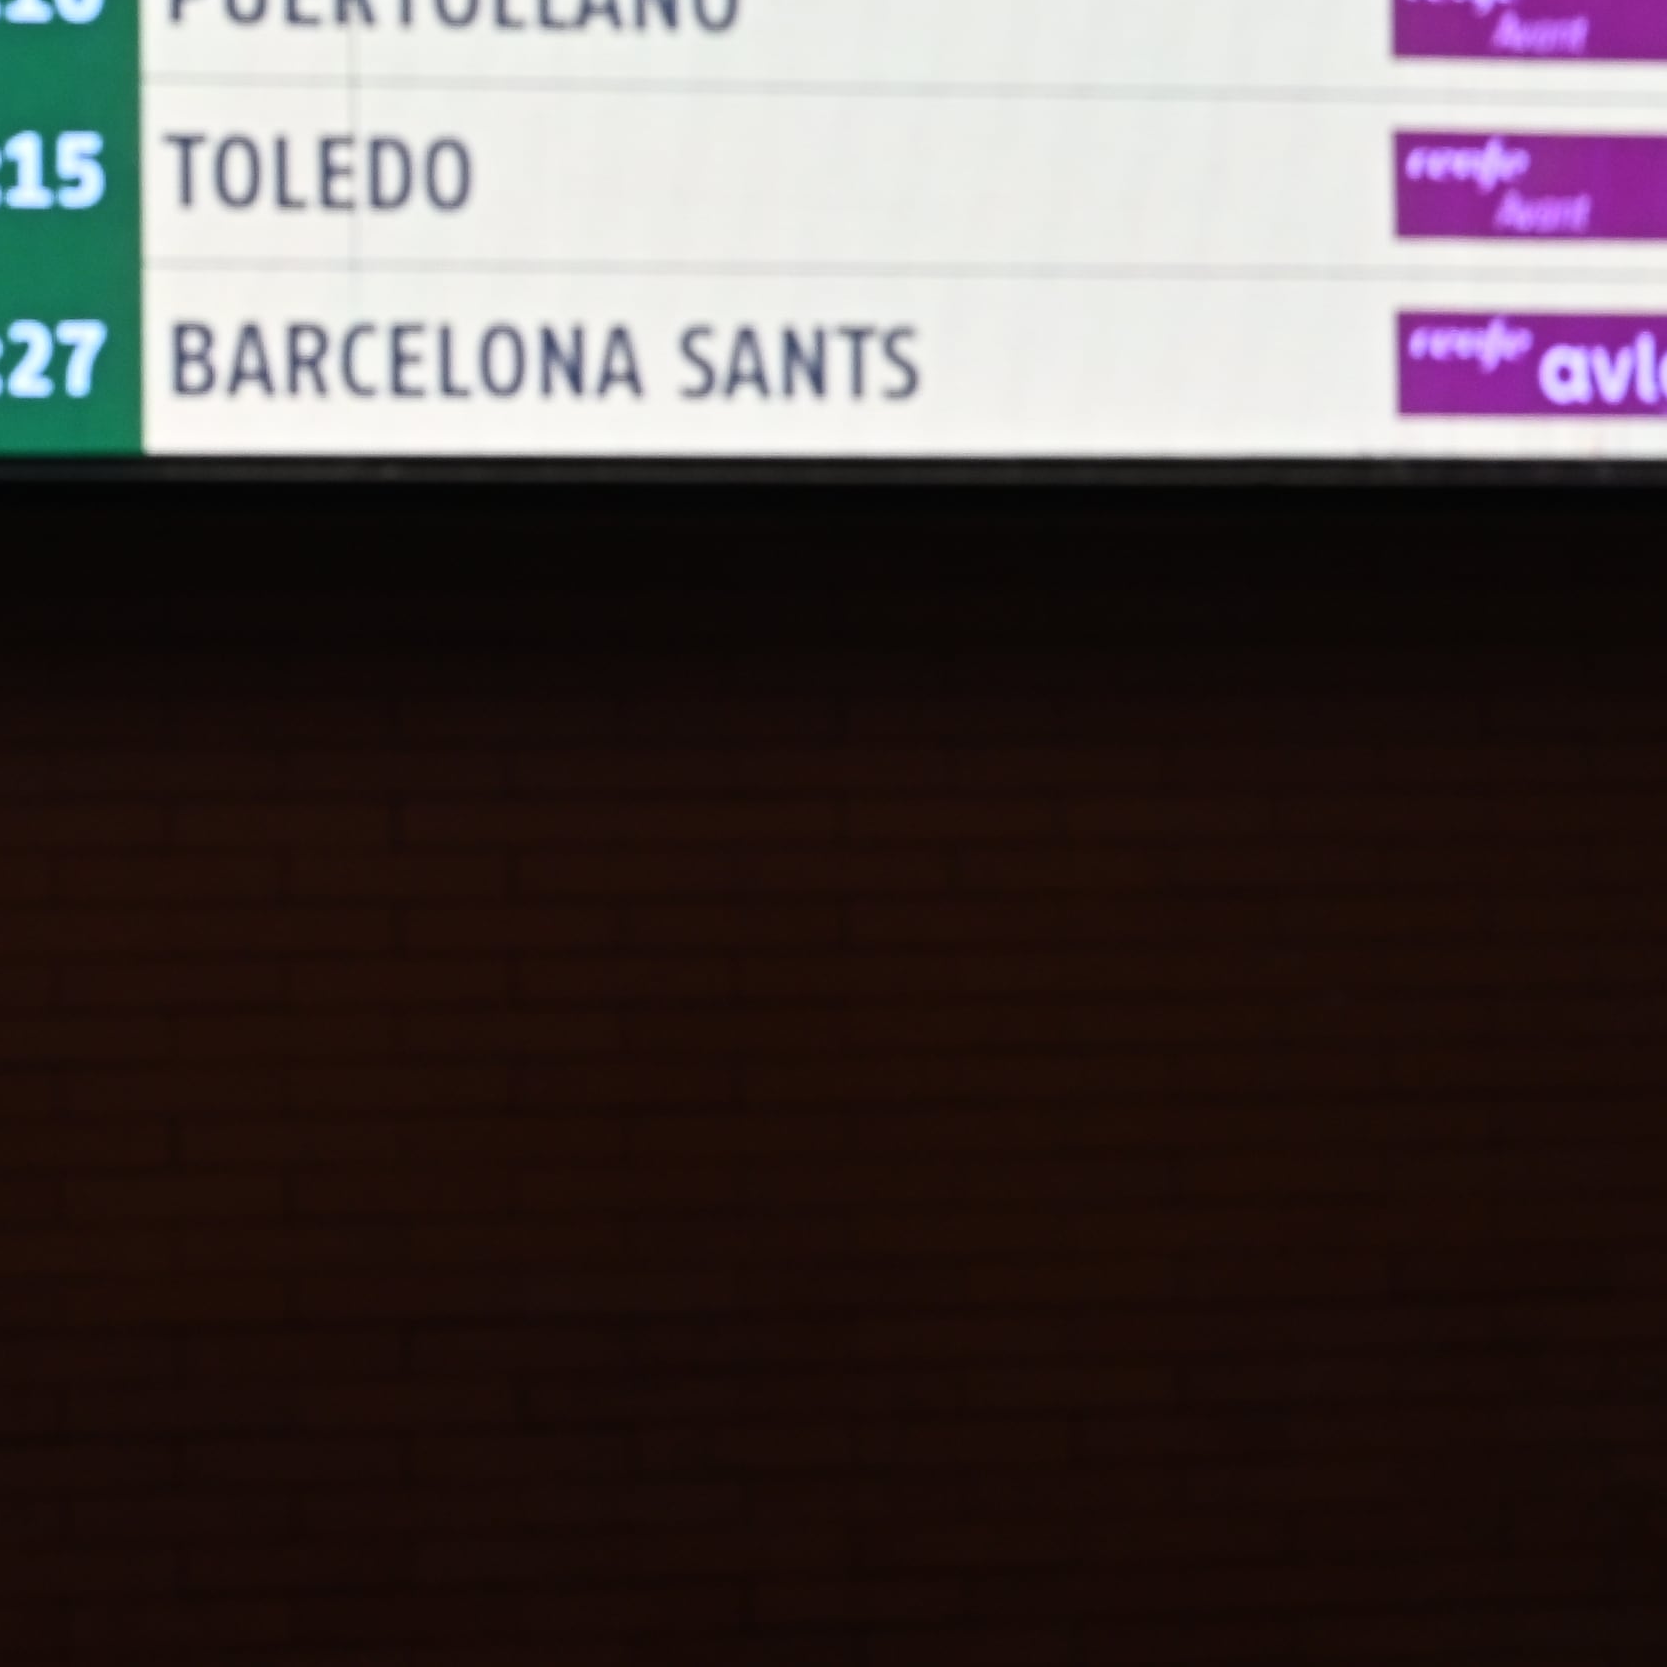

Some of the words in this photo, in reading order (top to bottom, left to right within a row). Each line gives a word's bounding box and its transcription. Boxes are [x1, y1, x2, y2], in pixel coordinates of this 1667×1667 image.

[162, 131, 474, 214] TOLEDO
[170, 319, 645, 400] BARCELONA
[678, 323, 921, 402] SANTS
[1537, 330, 1667, 406] avl
